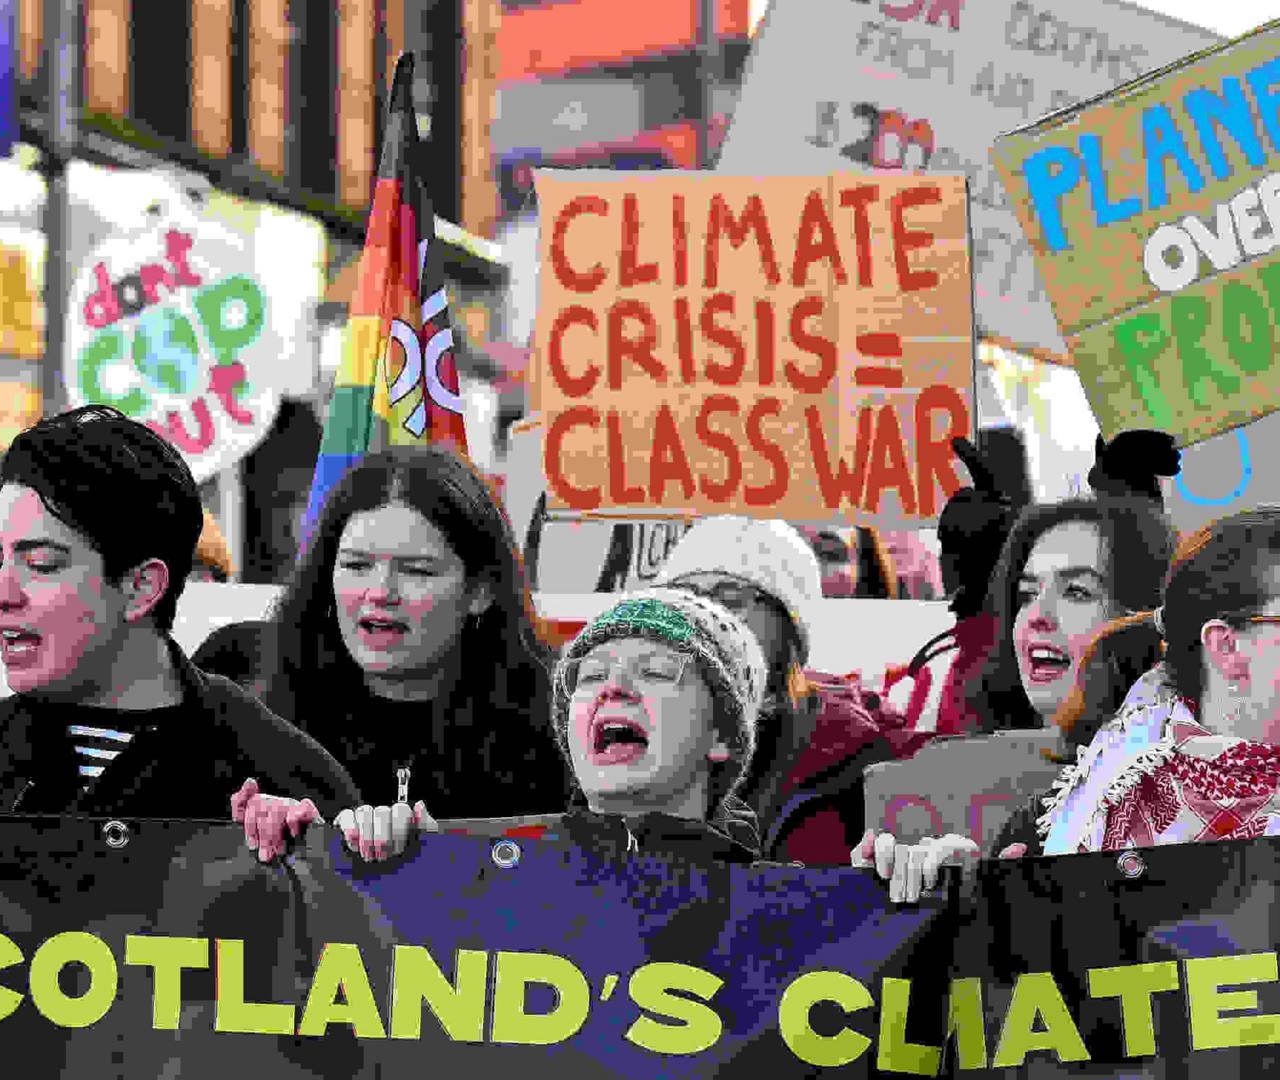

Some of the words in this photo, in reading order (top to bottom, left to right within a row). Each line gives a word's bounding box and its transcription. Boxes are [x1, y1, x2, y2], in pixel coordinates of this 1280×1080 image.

[83, 228, 203, 328] dont
[549, 185, 943, 293] CLIMATE
[544, 394, 790, 509] CLASS
[805, 384, 970, 517] WAR
